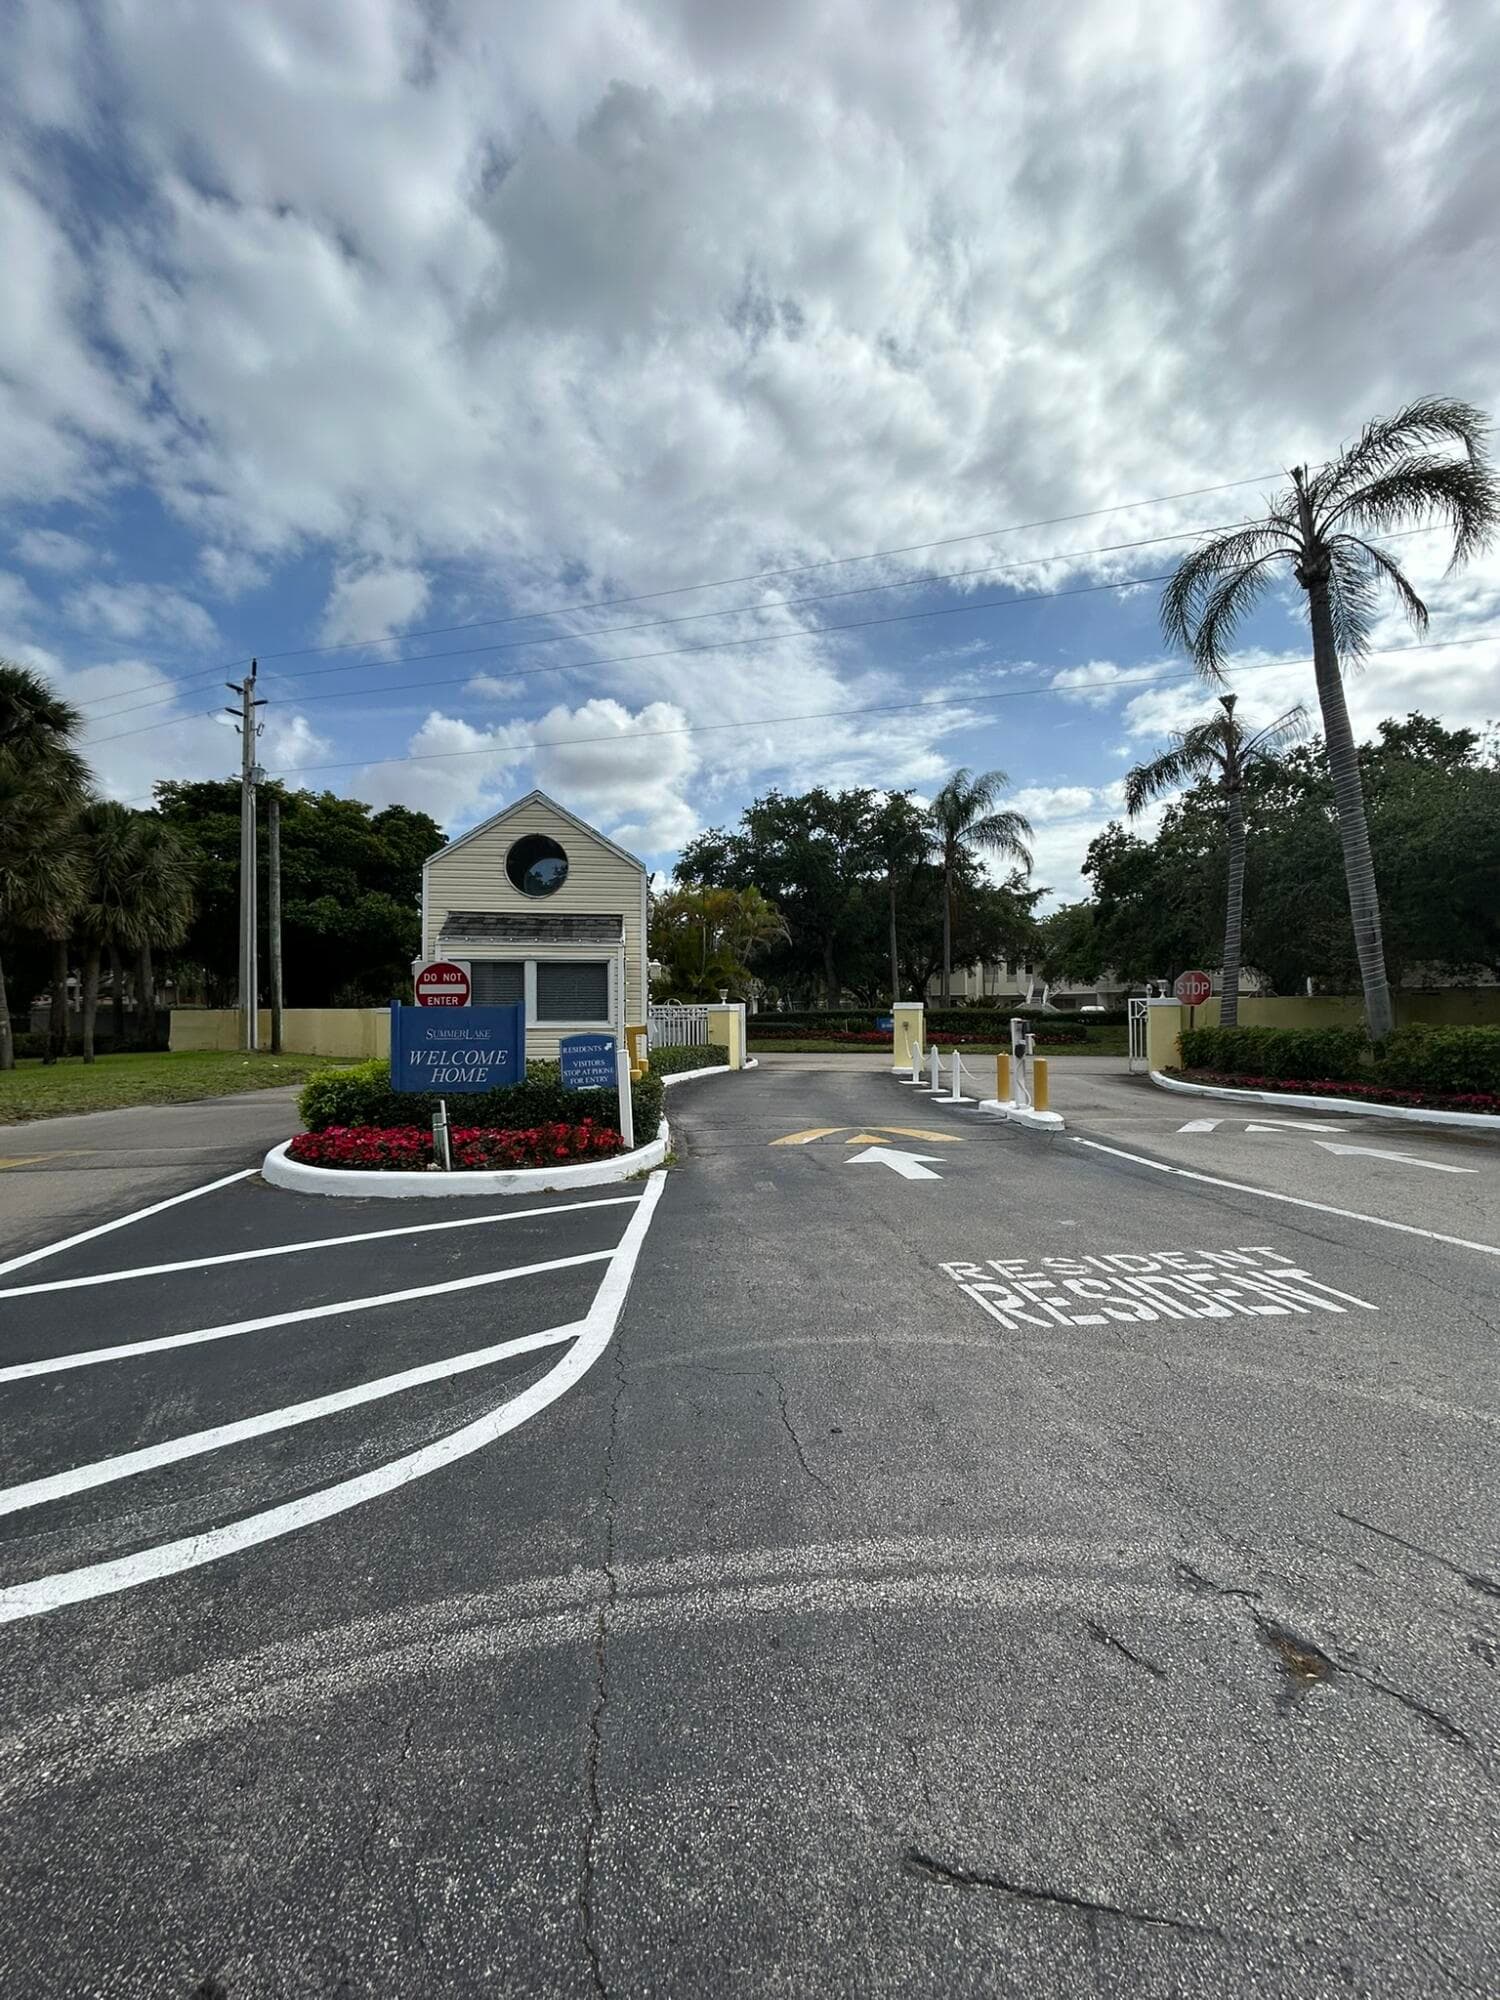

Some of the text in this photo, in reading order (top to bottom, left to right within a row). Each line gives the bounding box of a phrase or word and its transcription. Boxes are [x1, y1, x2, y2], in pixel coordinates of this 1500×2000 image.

[423, 973, 462, 982] DO NOT
[1177, 982, 1209, 995] STOP
[427, 996, 459, 1006] ENTER
[409, 1049, 508, 1066] WELCOME
[430, 1067, 489, 1083] HOME
[938, 1246, 1296, 1281] RESIDENT
[957, 1268, 1380, 1330] RESIDENT
